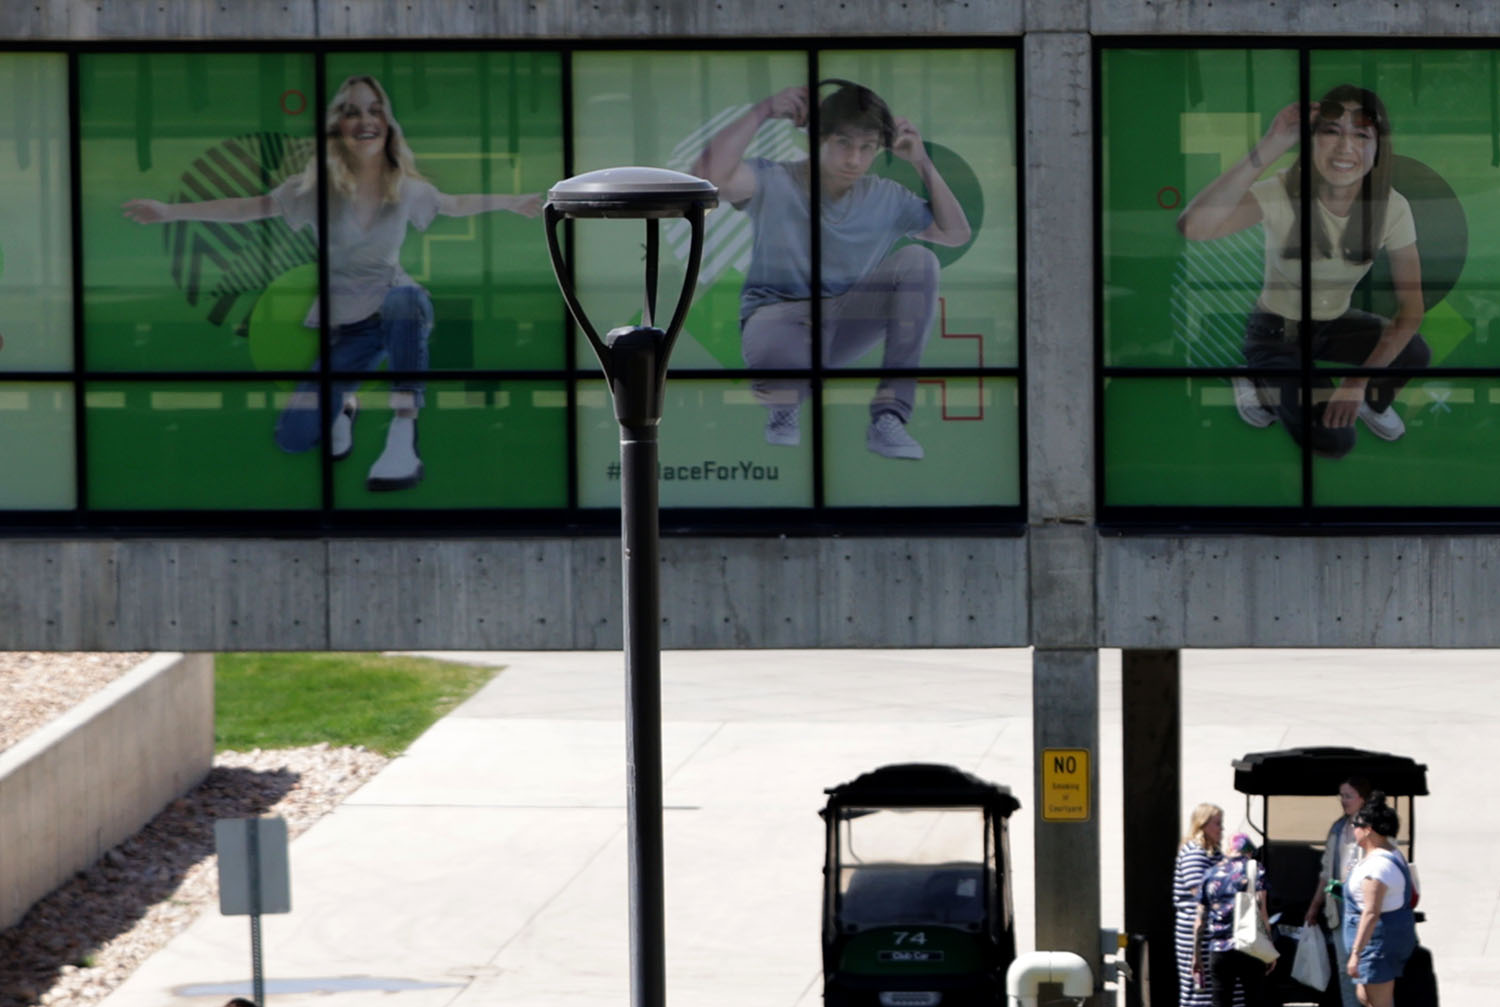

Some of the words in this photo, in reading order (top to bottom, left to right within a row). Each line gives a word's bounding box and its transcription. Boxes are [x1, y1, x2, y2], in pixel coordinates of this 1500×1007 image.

[607, 461, 779, 480] #laceForYou
[1054, 756, 1077, 774] NO
[893, 931, 927, 945] 74
